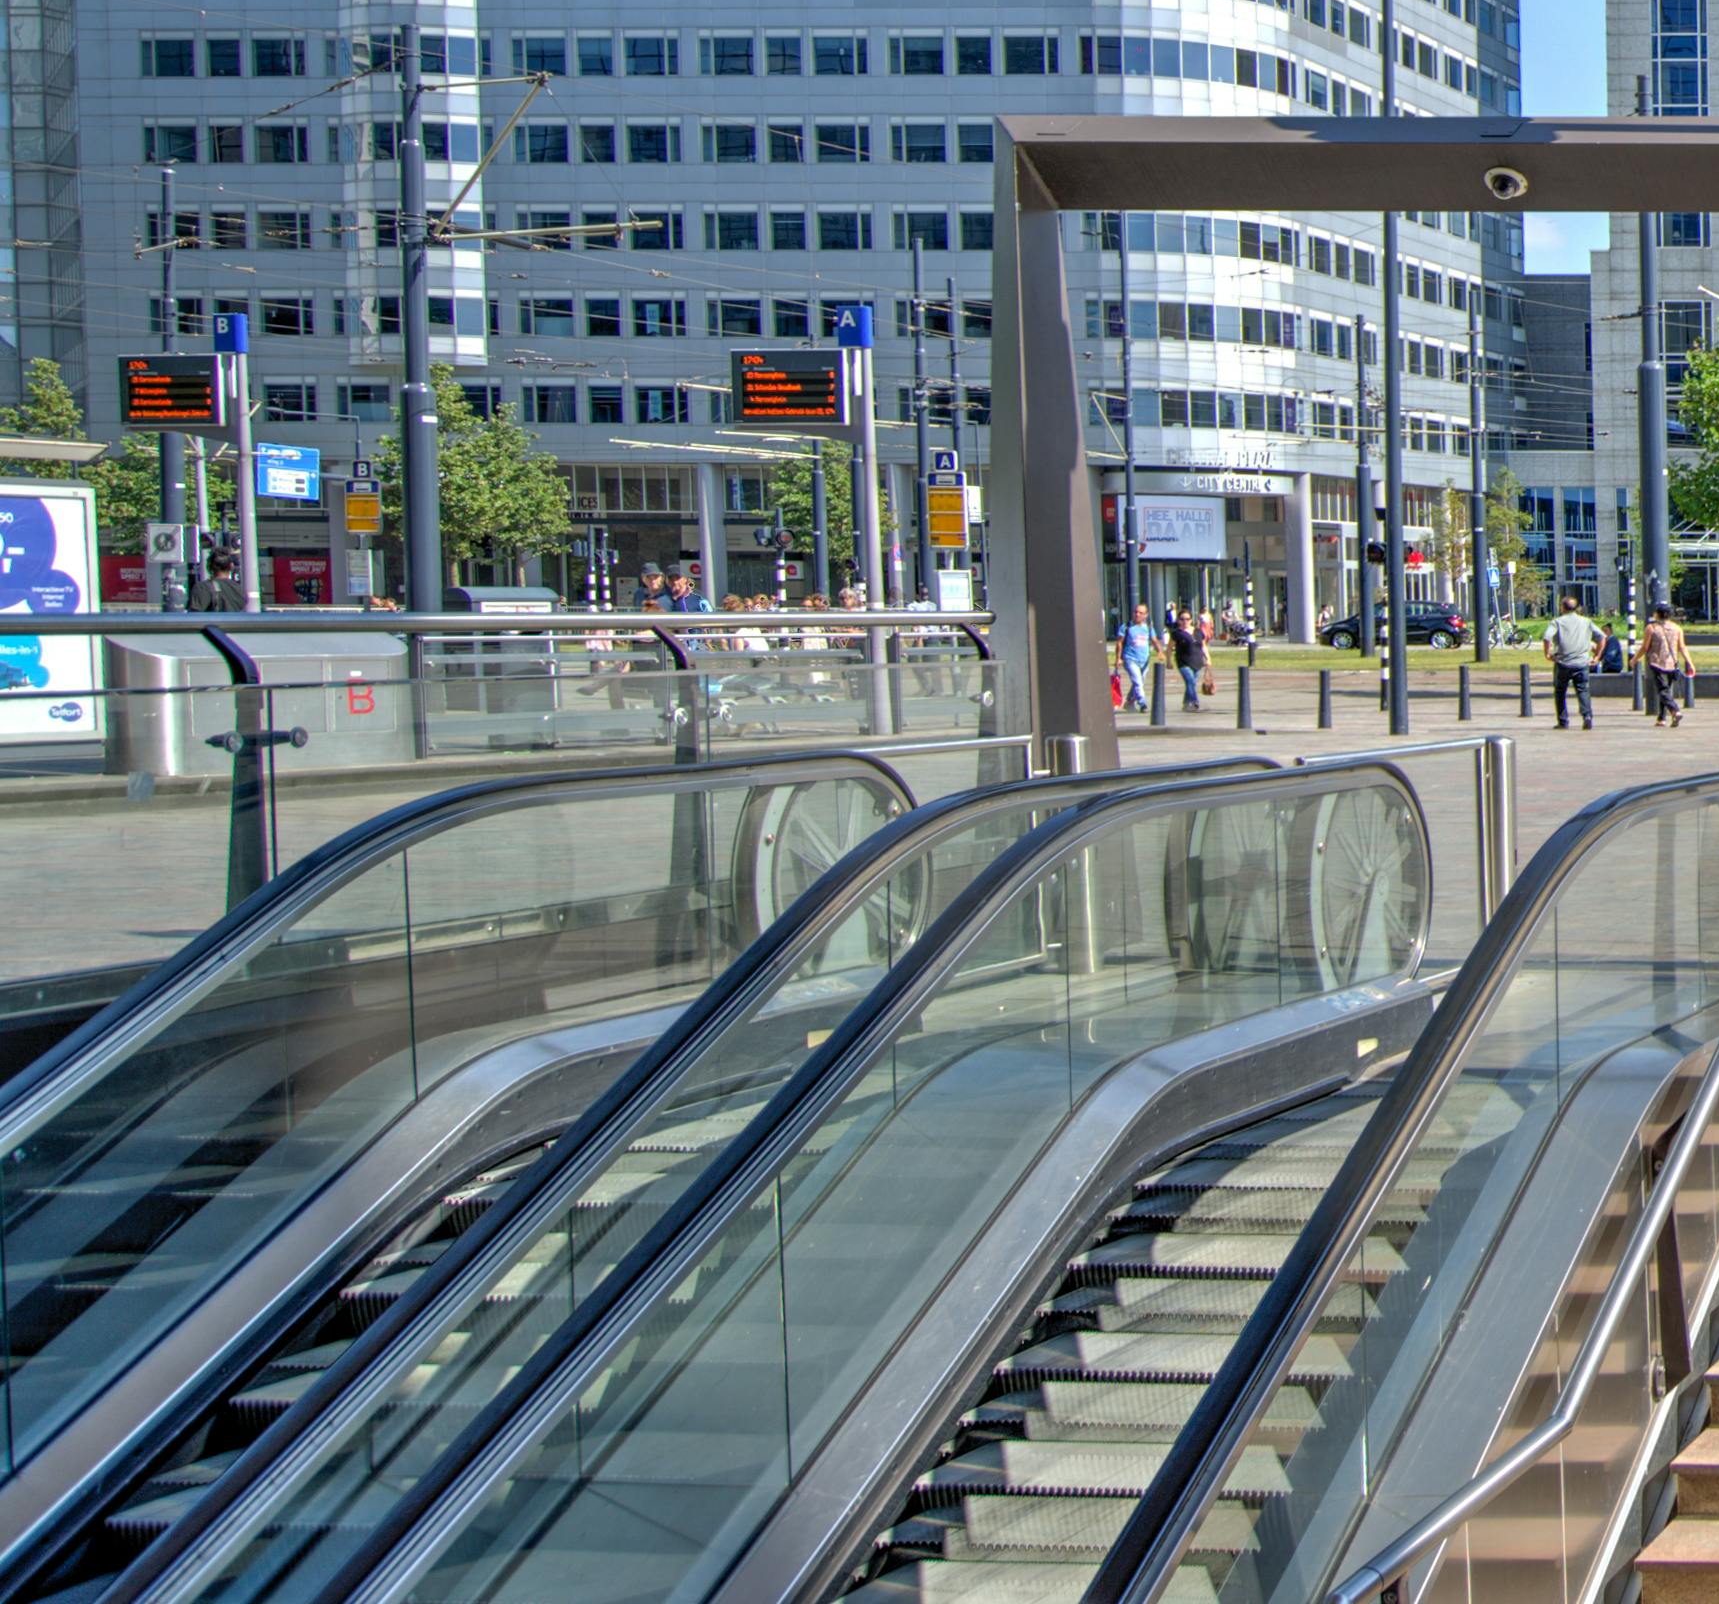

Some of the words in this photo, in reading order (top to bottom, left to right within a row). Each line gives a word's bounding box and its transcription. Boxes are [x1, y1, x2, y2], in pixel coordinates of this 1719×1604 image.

[840, 310, 856, 327] A
[217, 317, 228, 334] B
[940, 454, 951, 468] A
[358, 463, 368, 476] B
[1176, 510, 1212, 522] HALLO
[51, 707, 81, 717] Telfort
